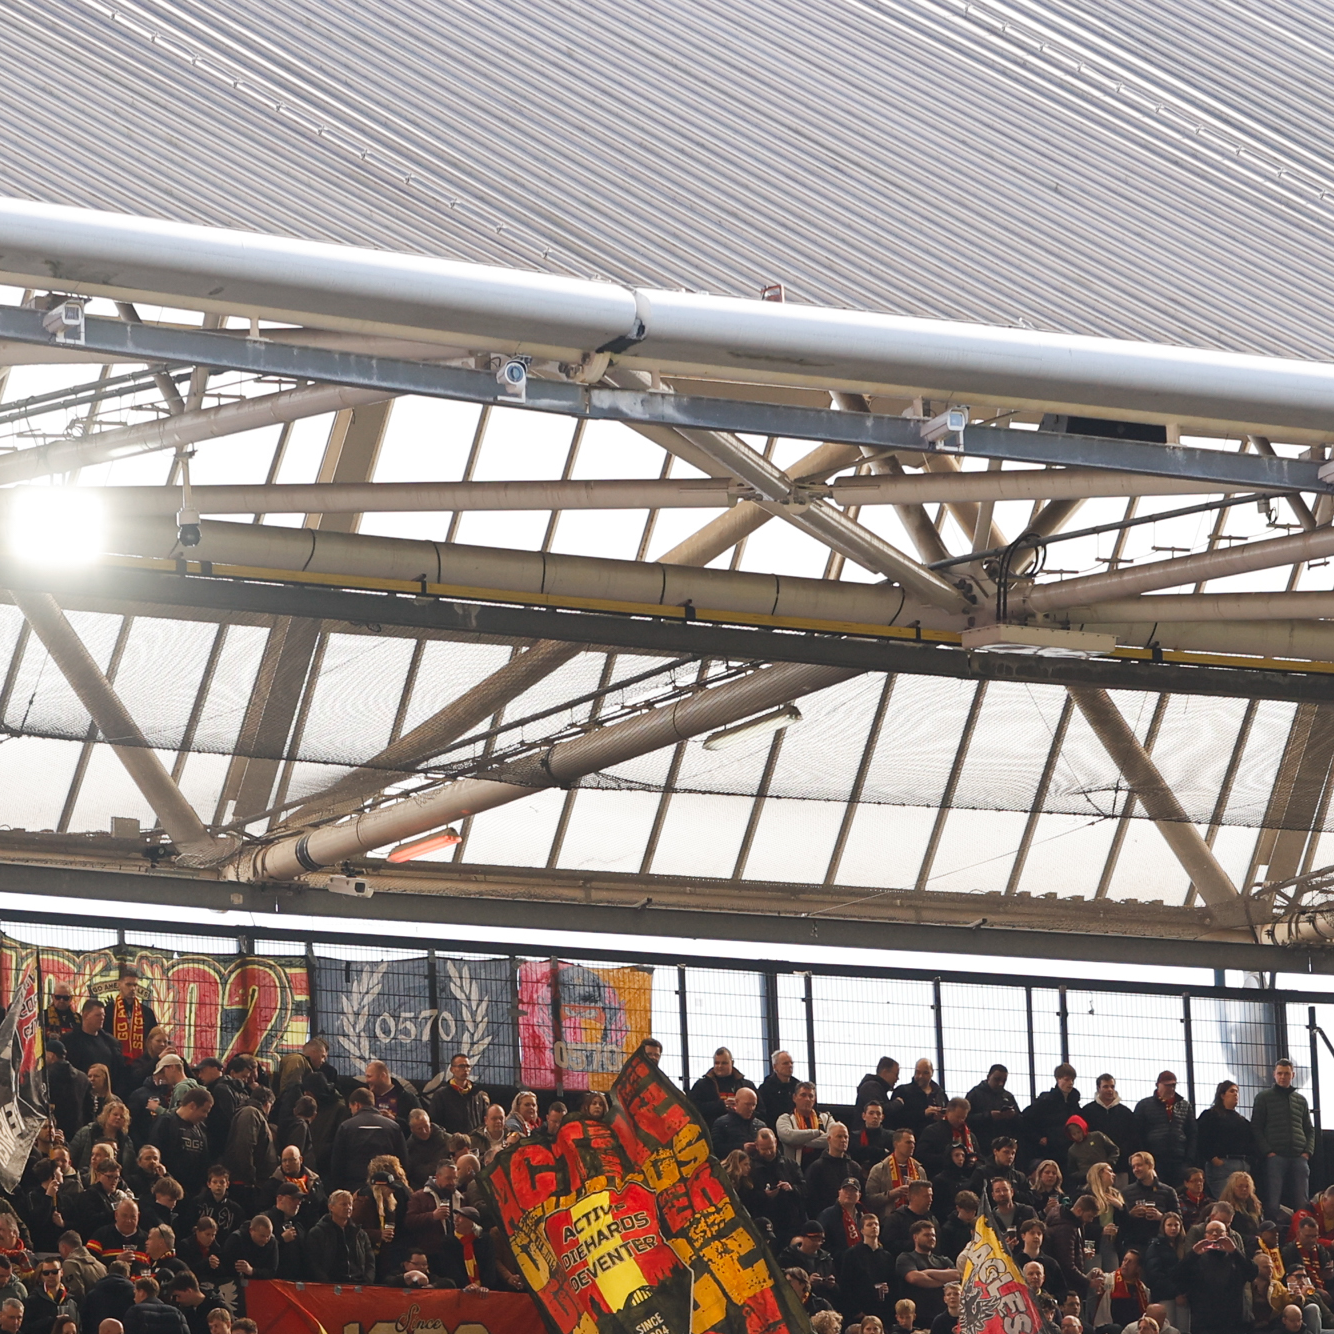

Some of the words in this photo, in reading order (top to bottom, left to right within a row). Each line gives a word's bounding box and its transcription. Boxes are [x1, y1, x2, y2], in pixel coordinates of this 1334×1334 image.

[375, 1009, 457, 1044] 0570
[554, 1041, 624, 1073] 0570
[562, 1211, 651, 1270] DIEHARDS
[569, 1234, 659, 1294] DEVENTER
[394, 1303, 444, 1333] Since
